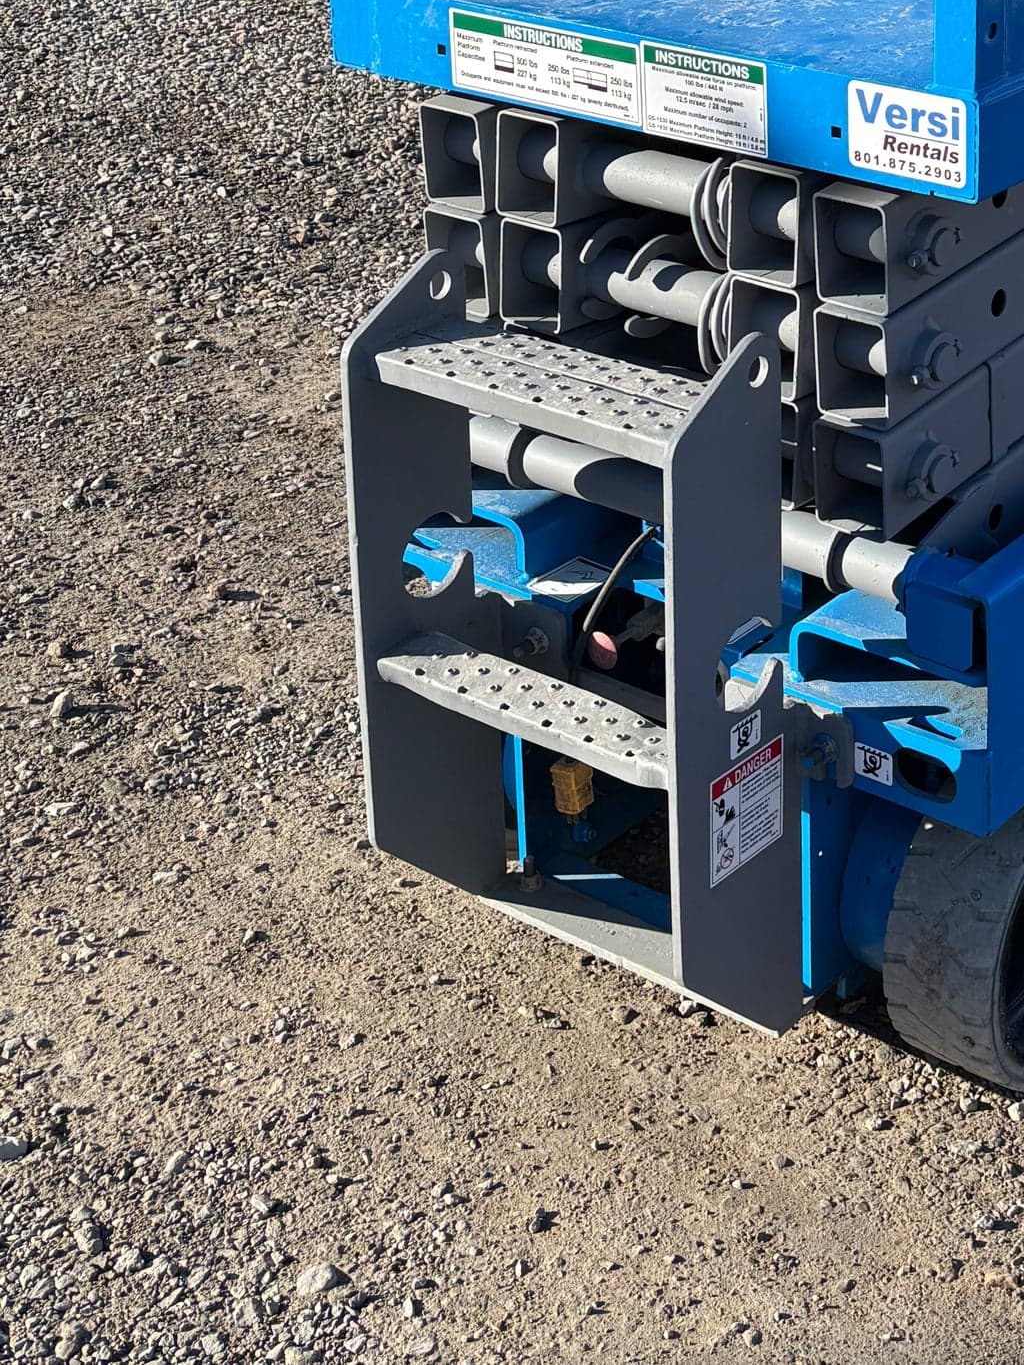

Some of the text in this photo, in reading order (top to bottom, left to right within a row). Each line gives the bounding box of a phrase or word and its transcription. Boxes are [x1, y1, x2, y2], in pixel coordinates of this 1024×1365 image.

[456, 32, 483, 44] Maximum
[503, 23, 583, 53] INSTRUCTIONS
[457, 41, 480, 52] Platform
[492, 40, 538, 54] Platform retracted
[458, 50, 485, 62] Capacities
[566, 54, 588, 64] Platform
[516, 57, 538, 68] 500 lbs
[655, 49, 750, 80] INSTRUCTIONS
[517, 69, 537, 82] 227 kg
[548, 64, 570, 75] 250 lbs
[550, 76, 570, 88] 113 kg
[610, 77, 632, 88] 250 lbs
[611, 90, 632, 102] 113 kg
[714, 96, 726, 104] wind
[676, 96, 688, 104] 12.5
[720, 105, 734, 114] mph
[856, 88, 960, 141] Versi
[882, 134, 959, 164] Rentals
[854, 150, 962, 183] 801.875.2903
[734, 747, 772, 784] DANGER
